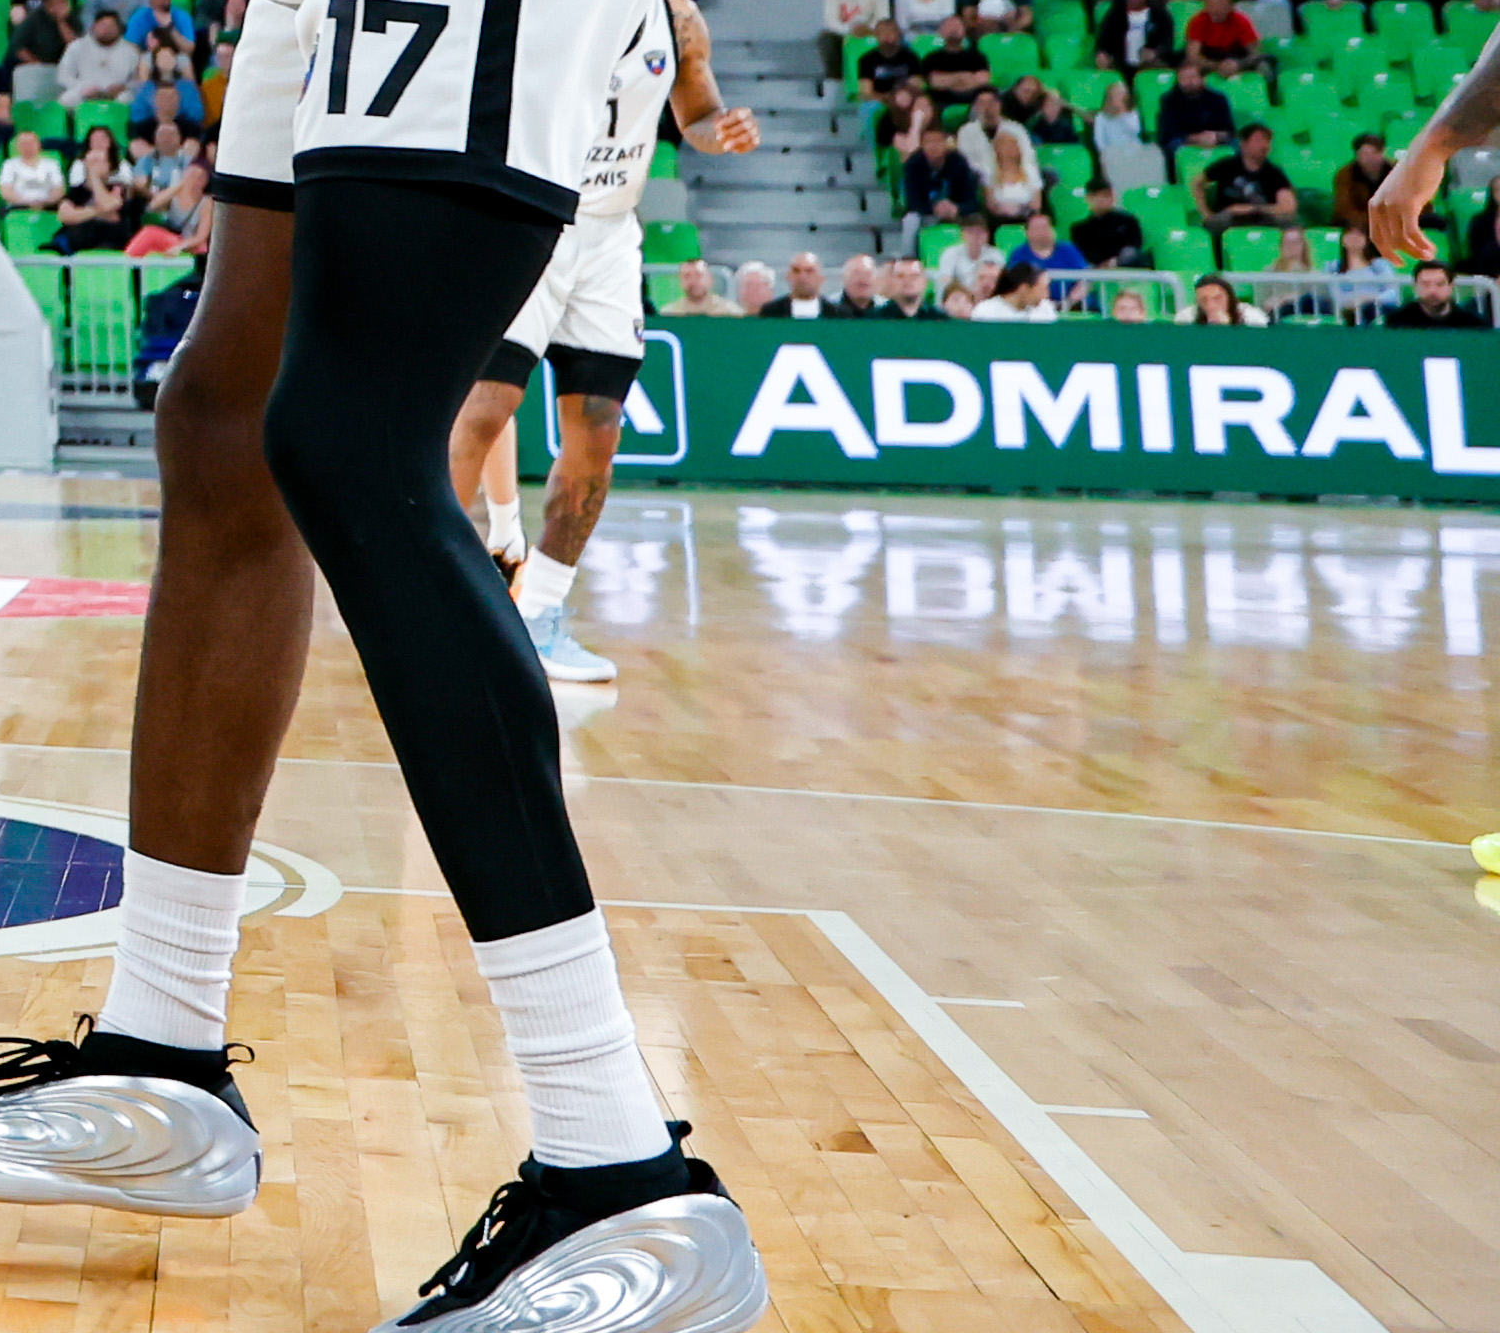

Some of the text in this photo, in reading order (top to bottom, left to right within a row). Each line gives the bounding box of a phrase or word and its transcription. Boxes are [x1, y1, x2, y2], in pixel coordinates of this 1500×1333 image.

[586, 143, 646, 163] ZZART
[594, 170, 628, 187] NIS
[731, 343, 1500, 476] ADMIRAL
